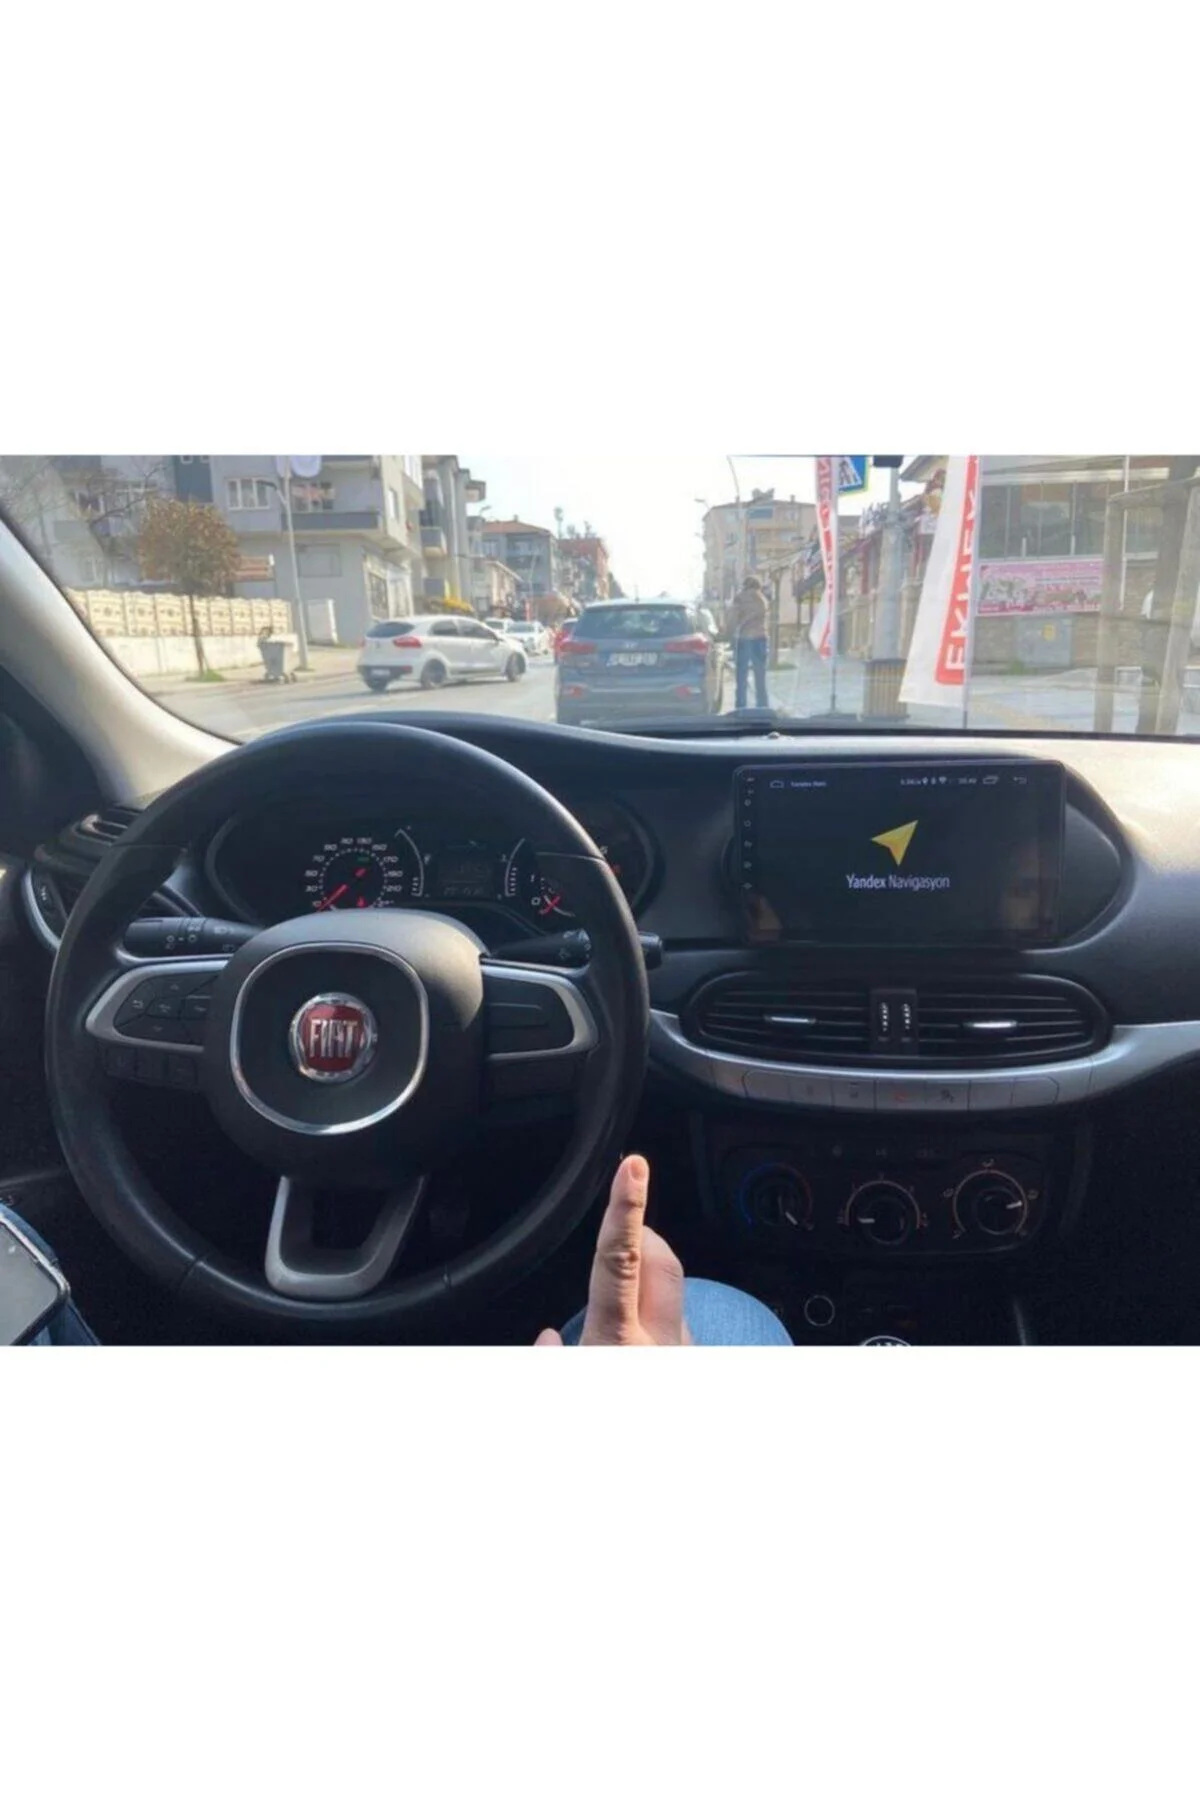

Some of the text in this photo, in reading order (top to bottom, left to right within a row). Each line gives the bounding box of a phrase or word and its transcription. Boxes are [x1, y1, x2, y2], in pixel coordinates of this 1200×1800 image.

[845, 873, 951, 892] Yandex Navigasyon
[309, 1019, 358, 1058] FIAT
